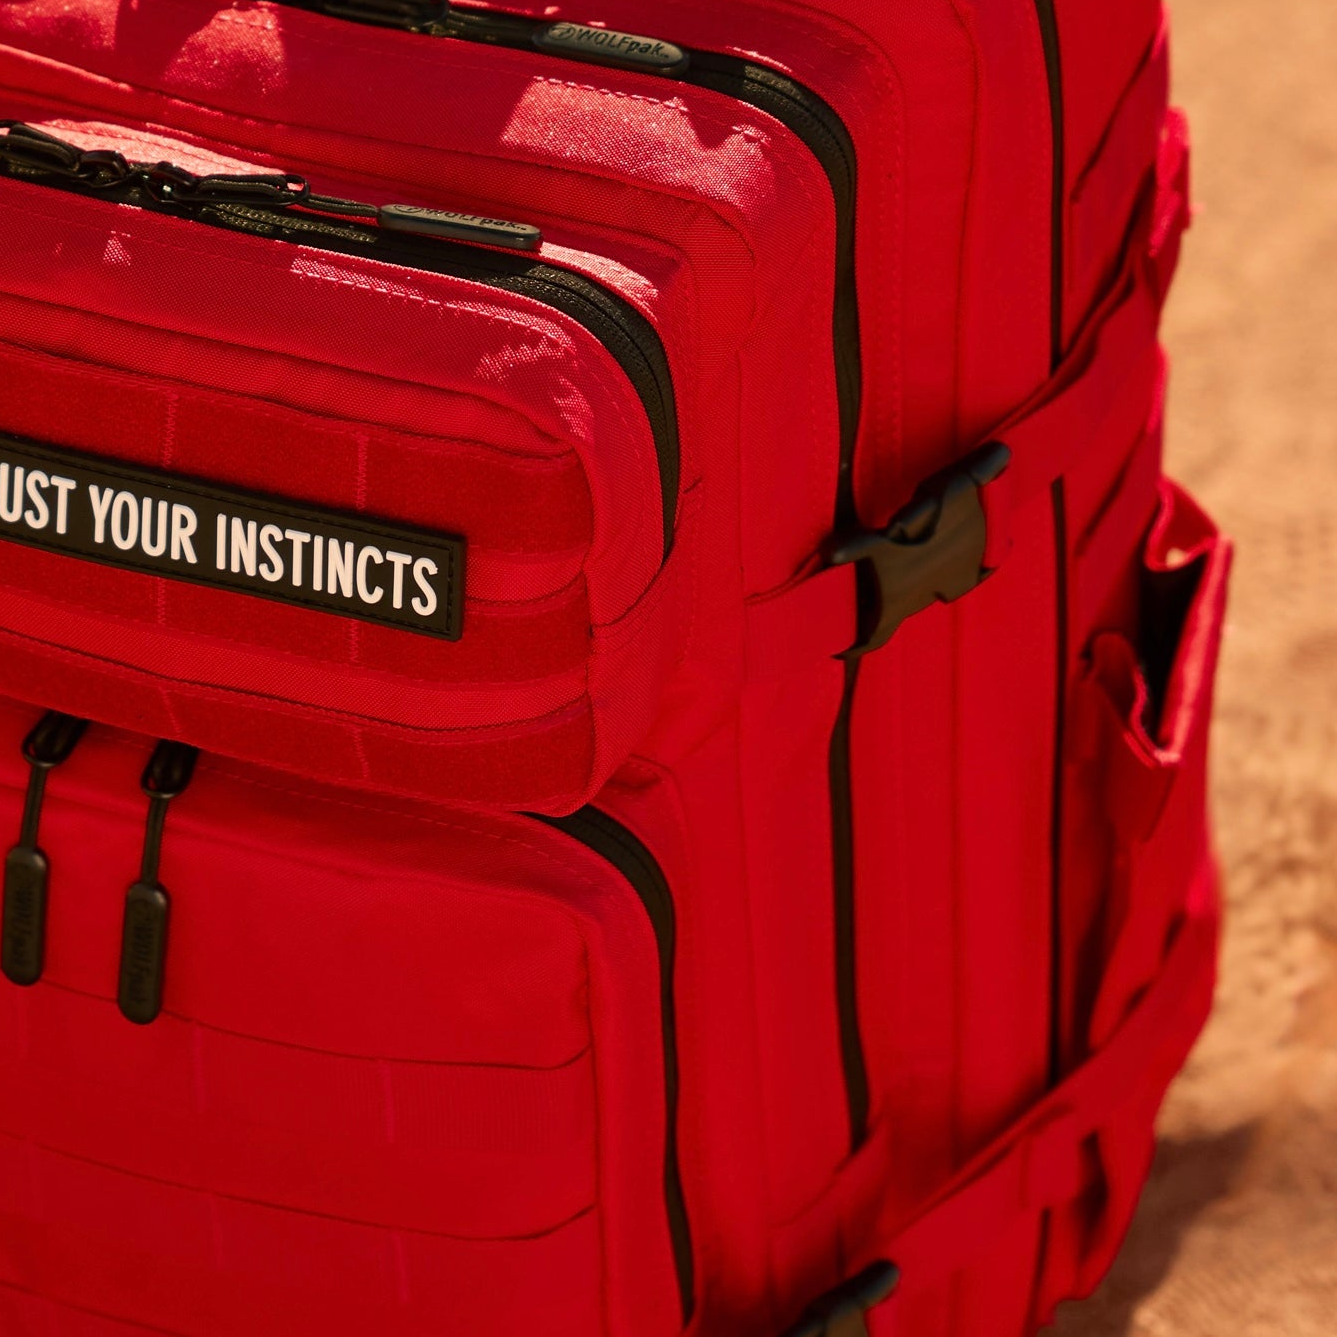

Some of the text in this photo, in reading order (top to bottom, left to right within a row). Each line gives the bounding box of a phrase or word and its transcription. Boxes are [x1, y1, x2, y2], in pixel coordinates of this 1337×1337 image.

[576, 27, 665, 56] WOLFpak
[88, 484, 198, 564] YOUR
[215, 513, 440, 617] INSTINCTS
